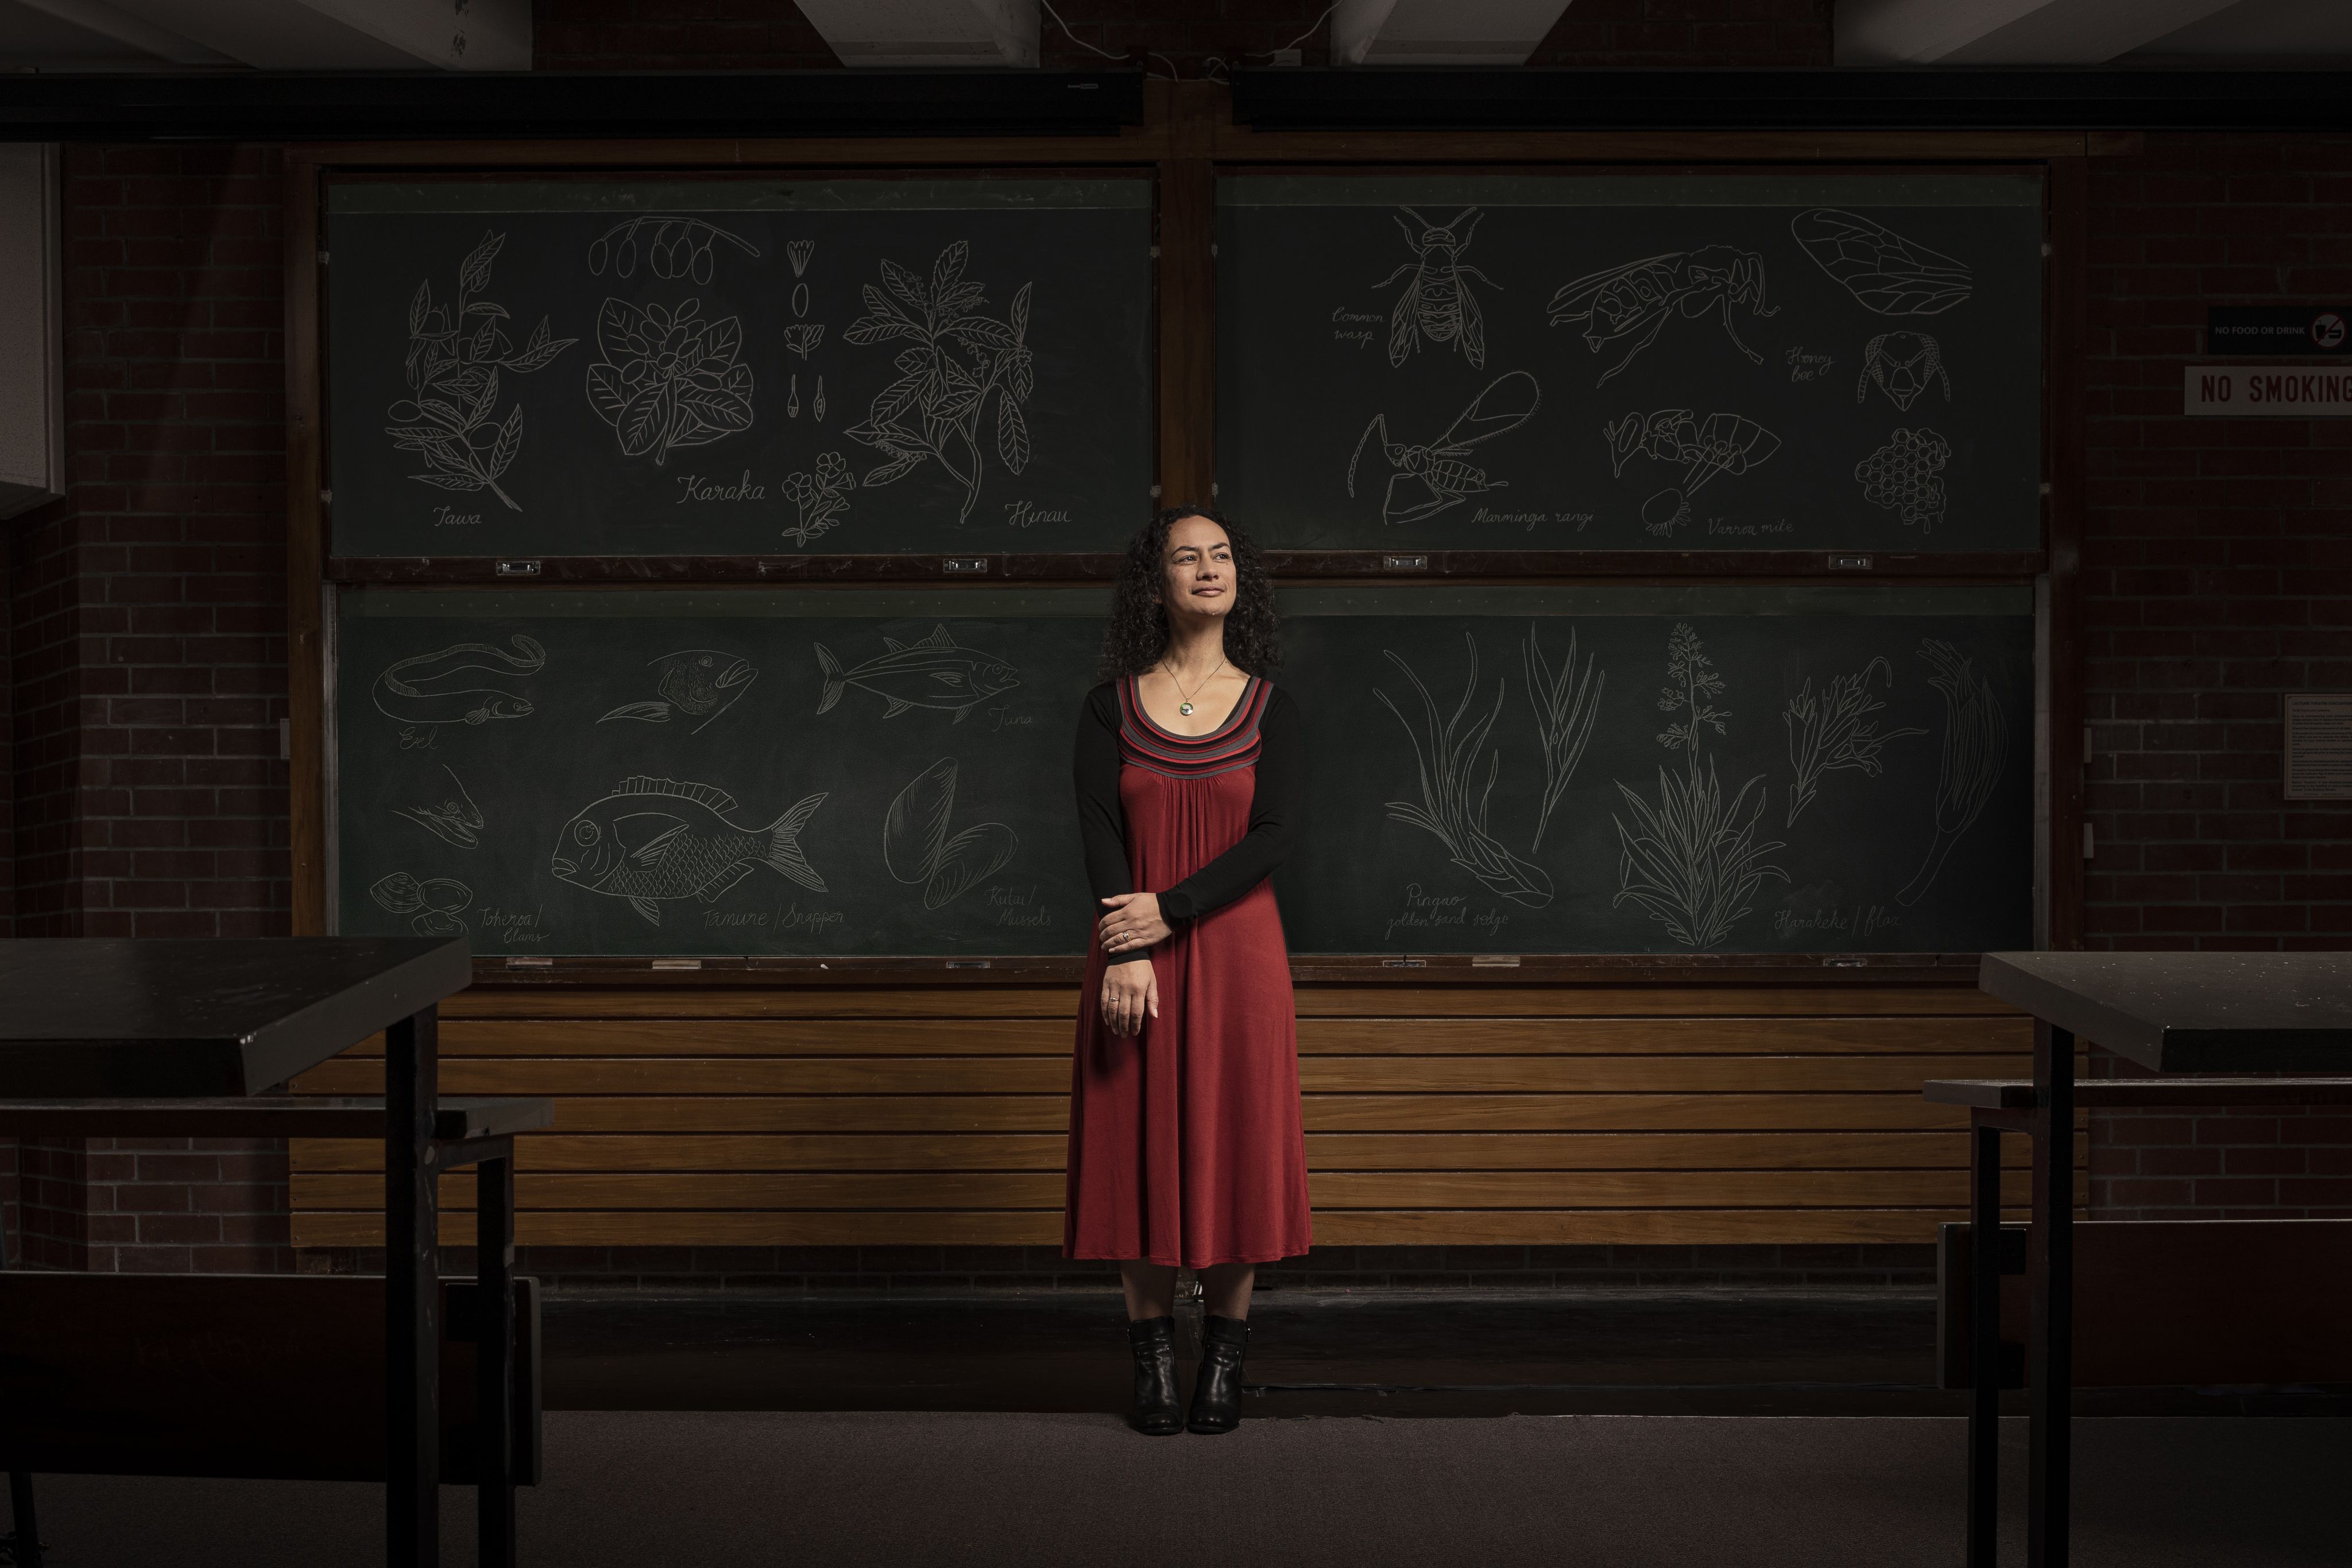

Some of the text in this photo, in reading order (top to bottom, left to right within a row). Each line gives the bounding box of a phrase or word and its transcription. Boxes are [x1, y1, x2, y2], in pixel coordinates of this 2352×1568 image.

[1332, 306, 1386, 322] Common
[1334, 330, 1375, 349] wasp
[2215, 326, 2305, 335] NO FOOD OR DRINK
[1786, 346, 1837, 375] Honey
[1792, 365, 1815, 382] bee
[2202, 375, 2352, 402] NO SMOKING
[676, 469, 765, 504] Karaka
[434, 505, 482, 526] Tawa
[1005, 500, 1073, 528] Hinau
[1708, 518, 1794, 535] Varroa mite
[988, 704, 1033, 732] Tuna
[399, 725, 440, 750] Eel
[996, 905, 1051, 926] Mussels
[1385, 907, 1509, 940] golden sand sedge
[1775, 909, 1848, 929] Harakeke
[1864, 905, 1902, 936] flax
[503, 927, 552, 944] Clams
